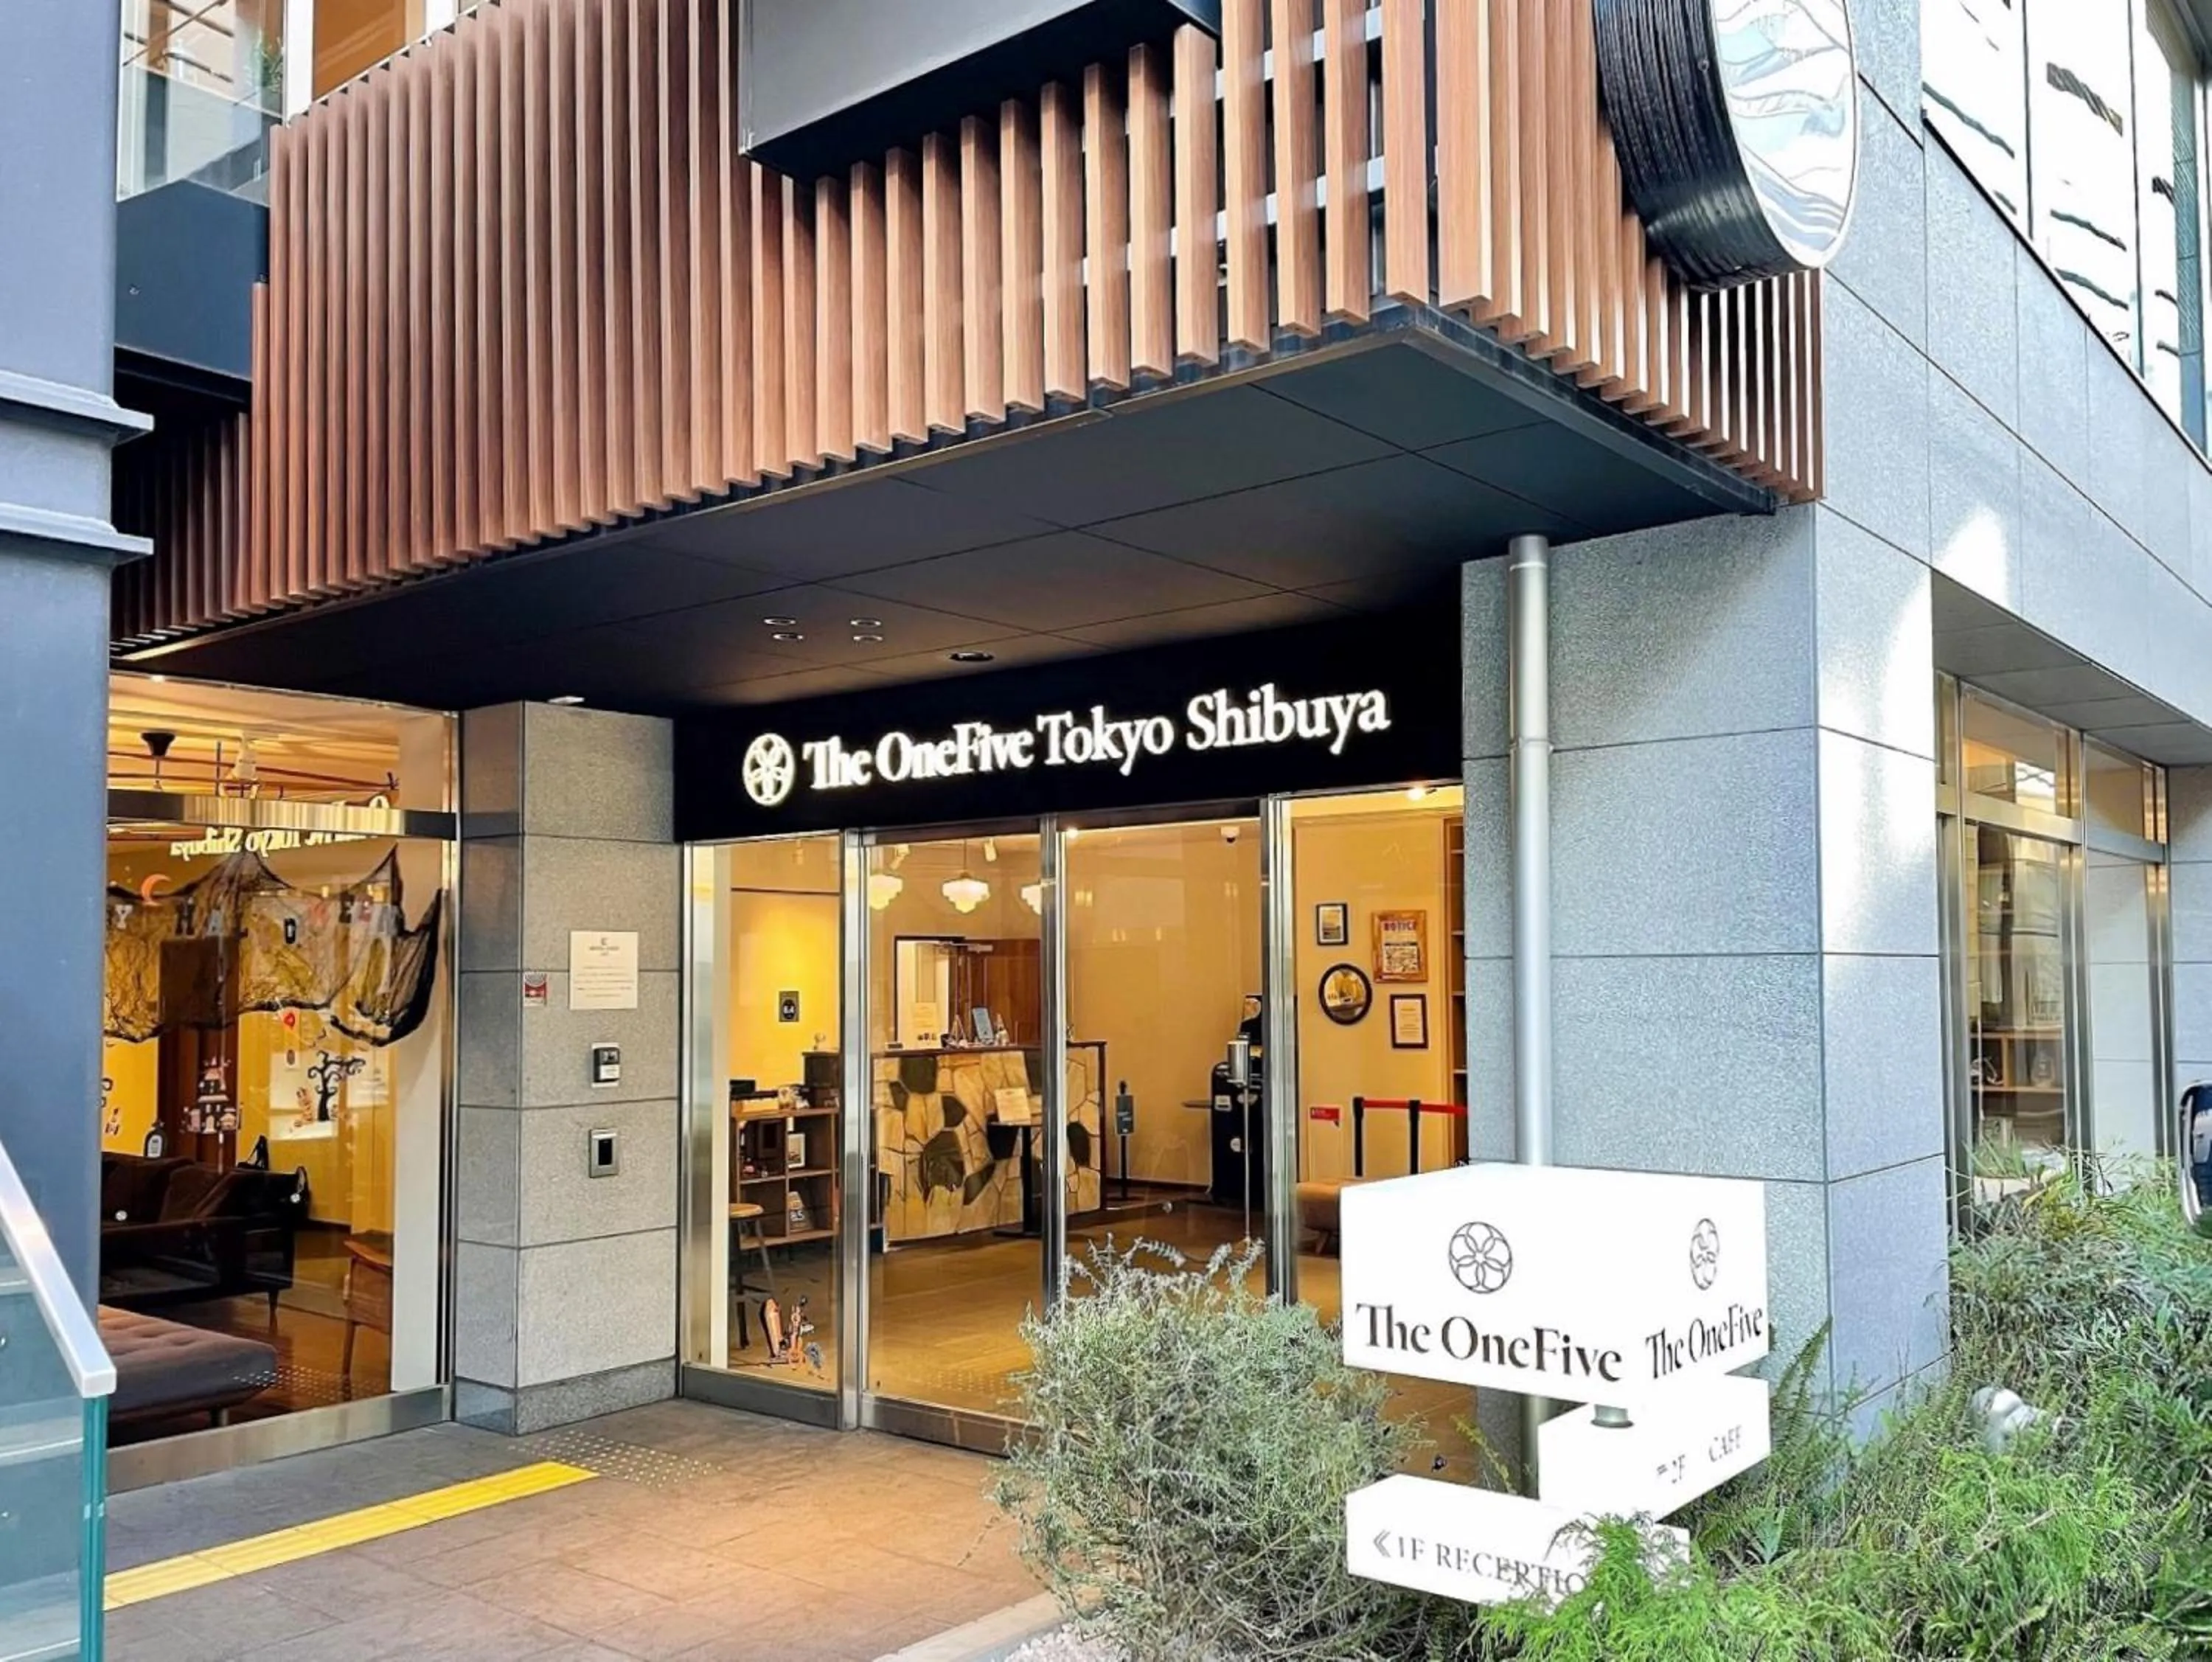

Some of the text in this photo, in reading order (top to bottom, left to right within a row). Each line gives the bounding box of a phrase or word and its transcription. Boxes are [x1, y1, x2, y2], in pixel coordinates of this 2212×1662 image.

[803, 683, 1391, 789] The OneFive Tokyo Shibuya
[1356, 1303, 1622, 1383] The OneFive
[1646, 1303, 1764, 1380] The OneFive
[1436, 1542, 1587, 1595] RECEPTIO
